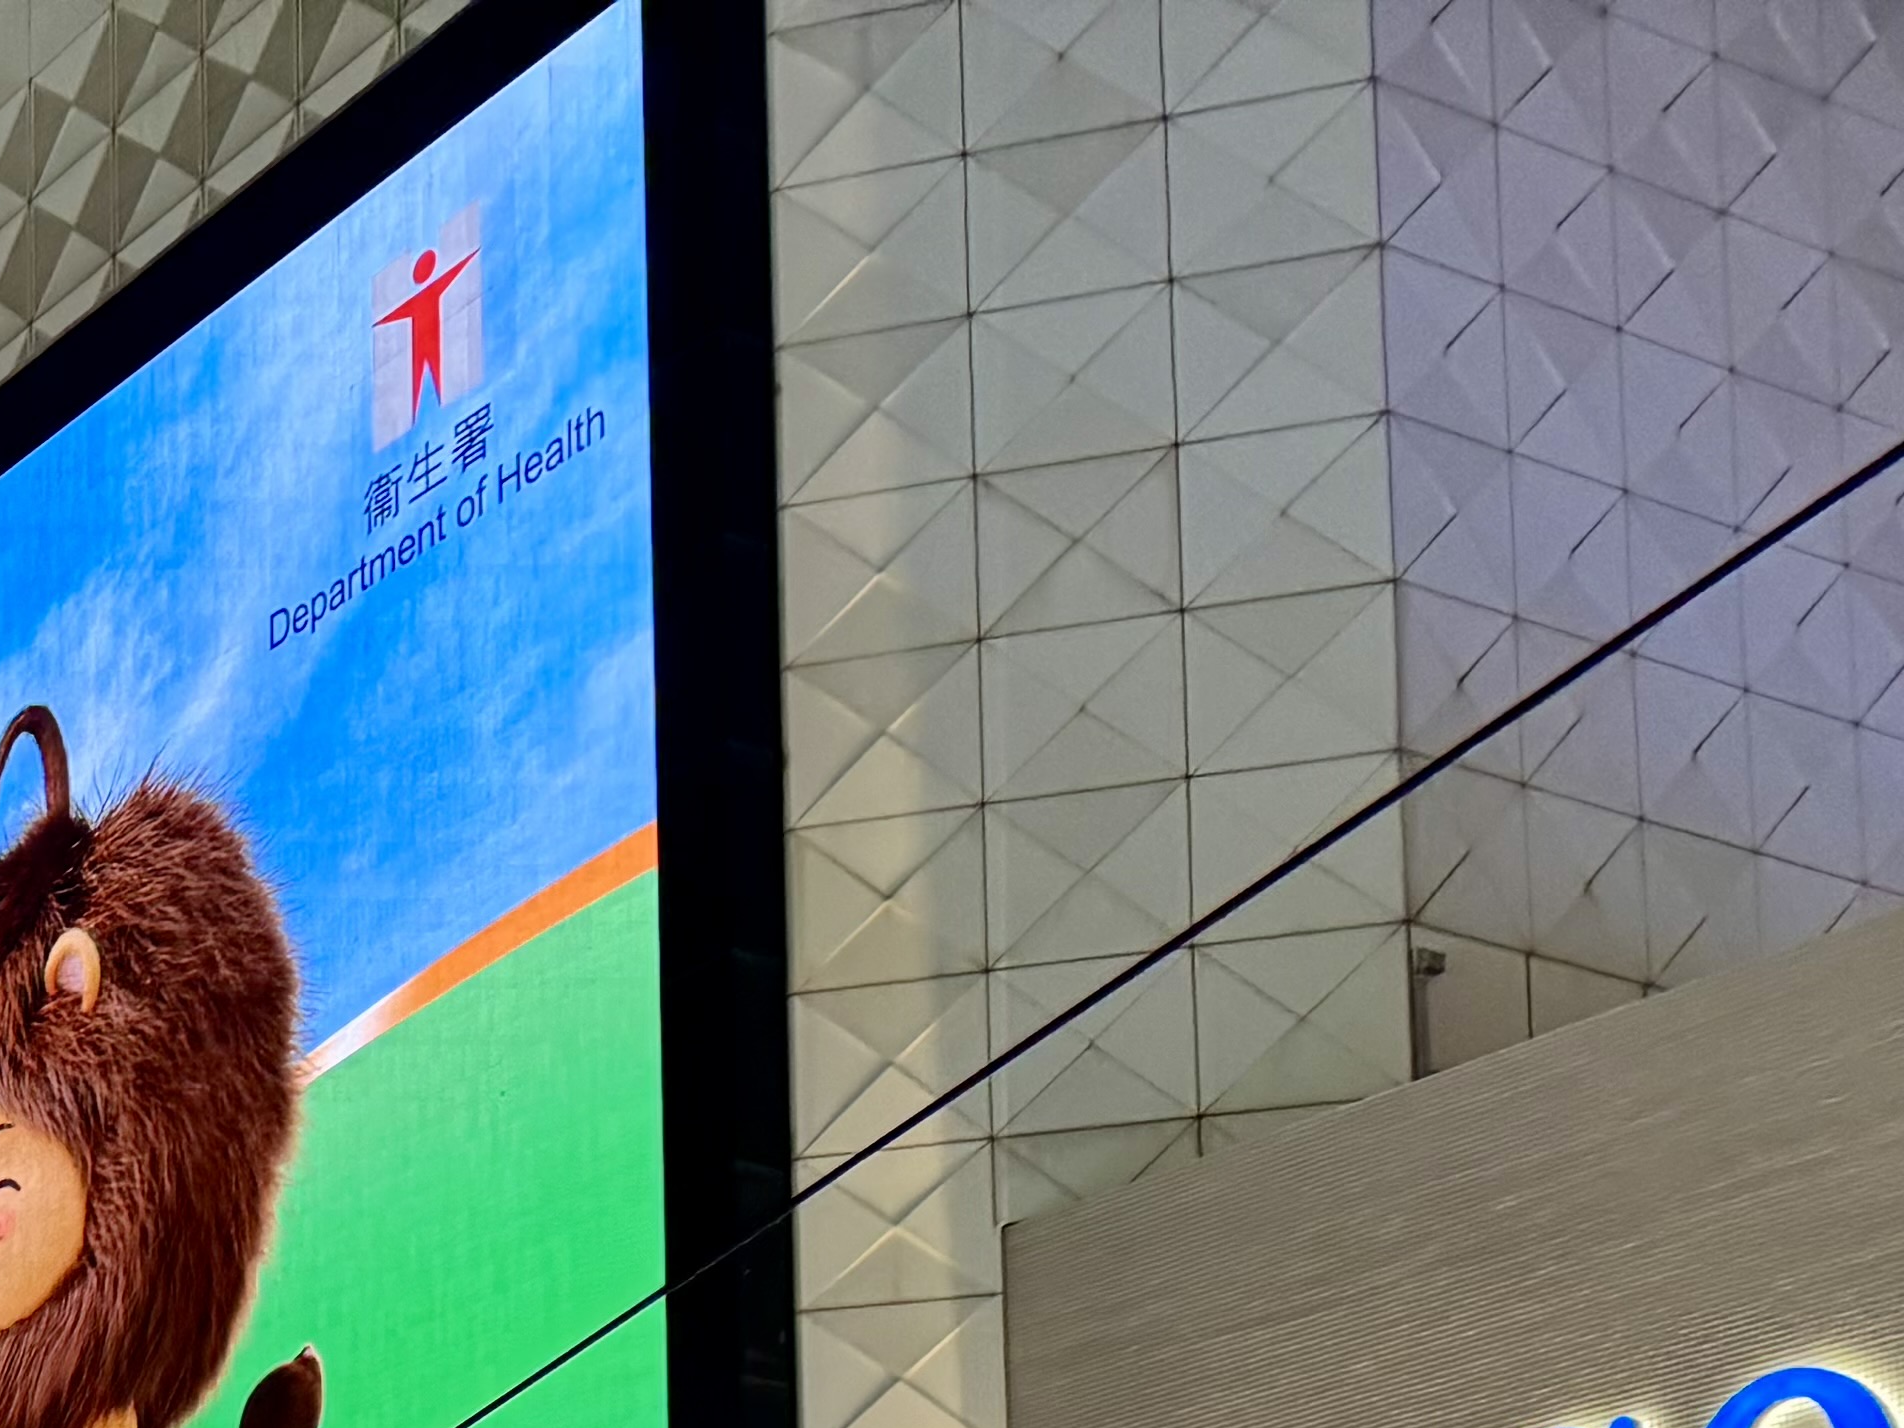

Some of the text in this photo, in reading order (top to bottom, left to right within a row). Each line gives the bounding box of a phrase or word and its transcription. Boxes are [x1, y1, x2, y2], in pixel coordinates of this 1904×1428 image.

[269, 406, 605, 650] Department of Health
